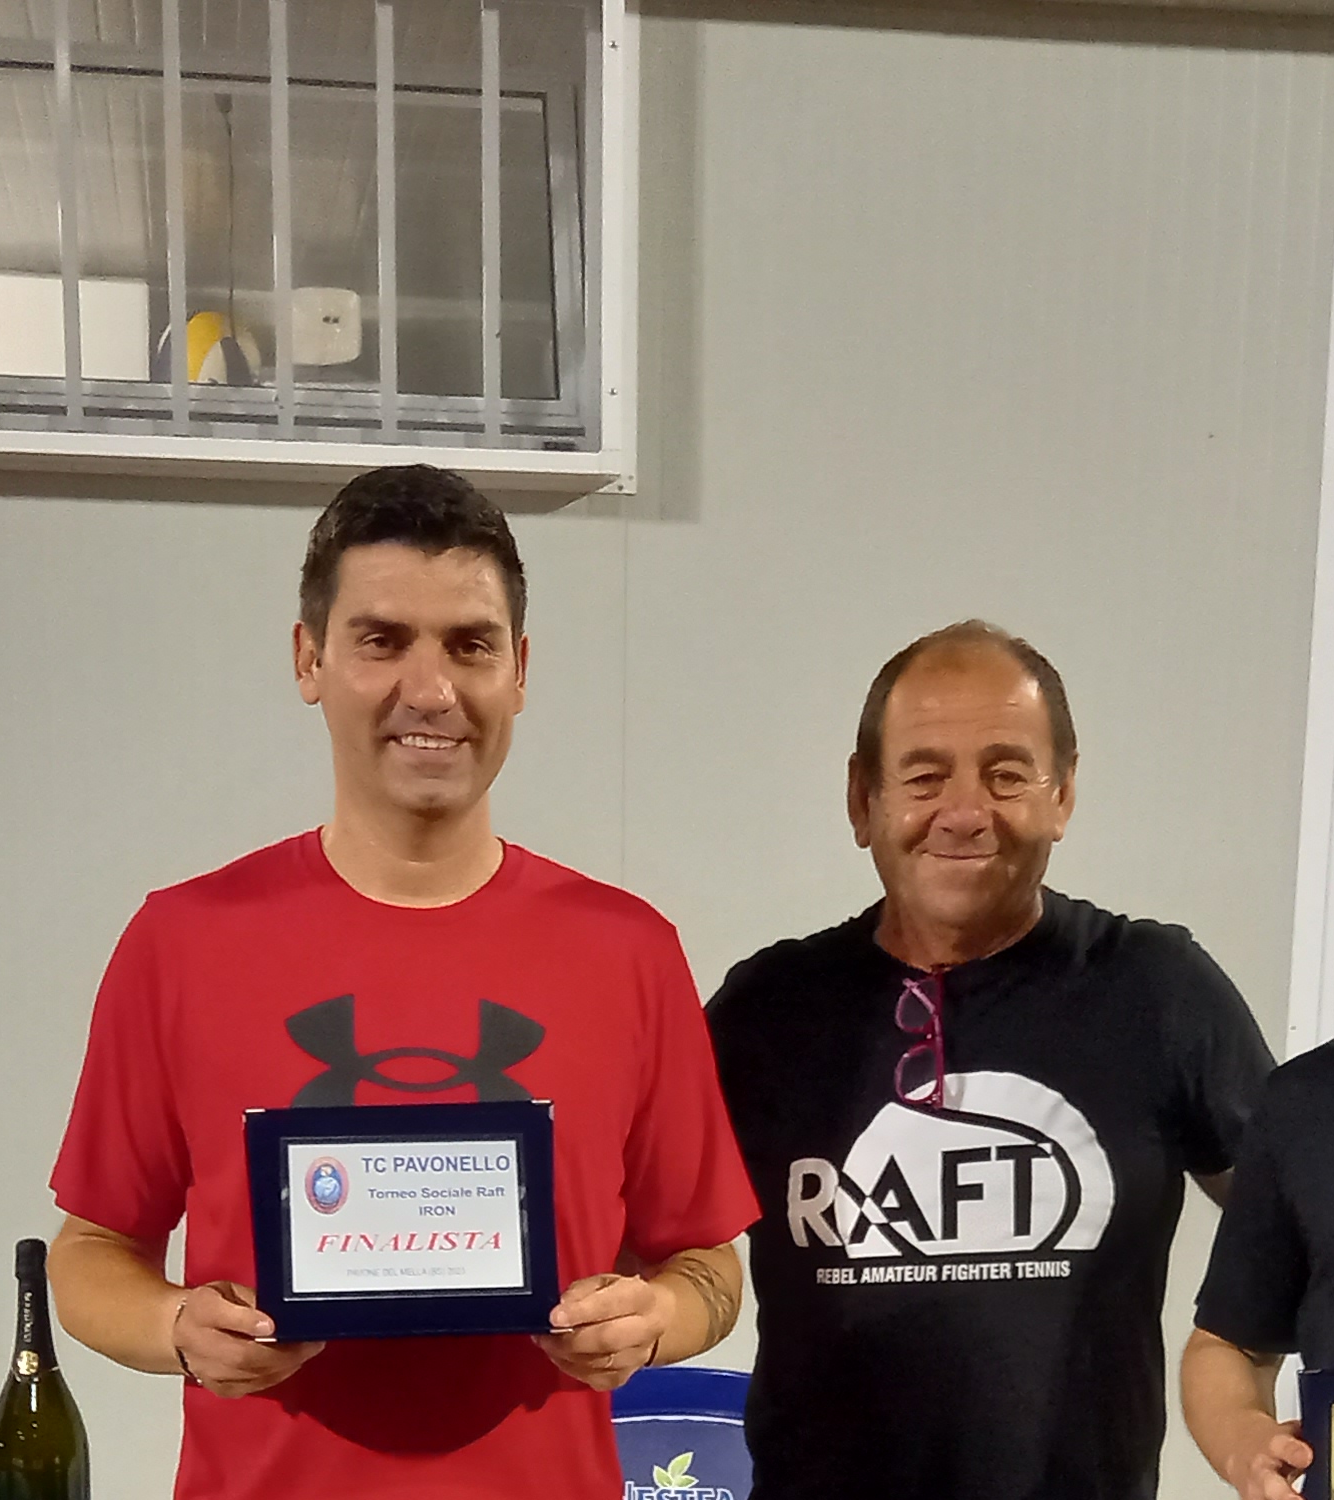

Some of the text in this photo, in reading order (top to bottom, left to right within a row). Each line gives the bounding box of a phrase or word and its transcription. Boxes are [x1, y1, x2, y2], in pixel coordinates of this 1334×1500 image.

[361, 1154, 511, 1173] TC PAVONELLO
[368, 1185, 506, 1199] Torneo Sociale Raft
[787, 1142, 1054, 1248] RAFT
[418, 1205, 456, 1217] IRON
[317, 1231, 502, 1253] FINALISTA
[816, 1260, 1072, 1285] REBEL AMATEUR FIGHTER TENNIS
